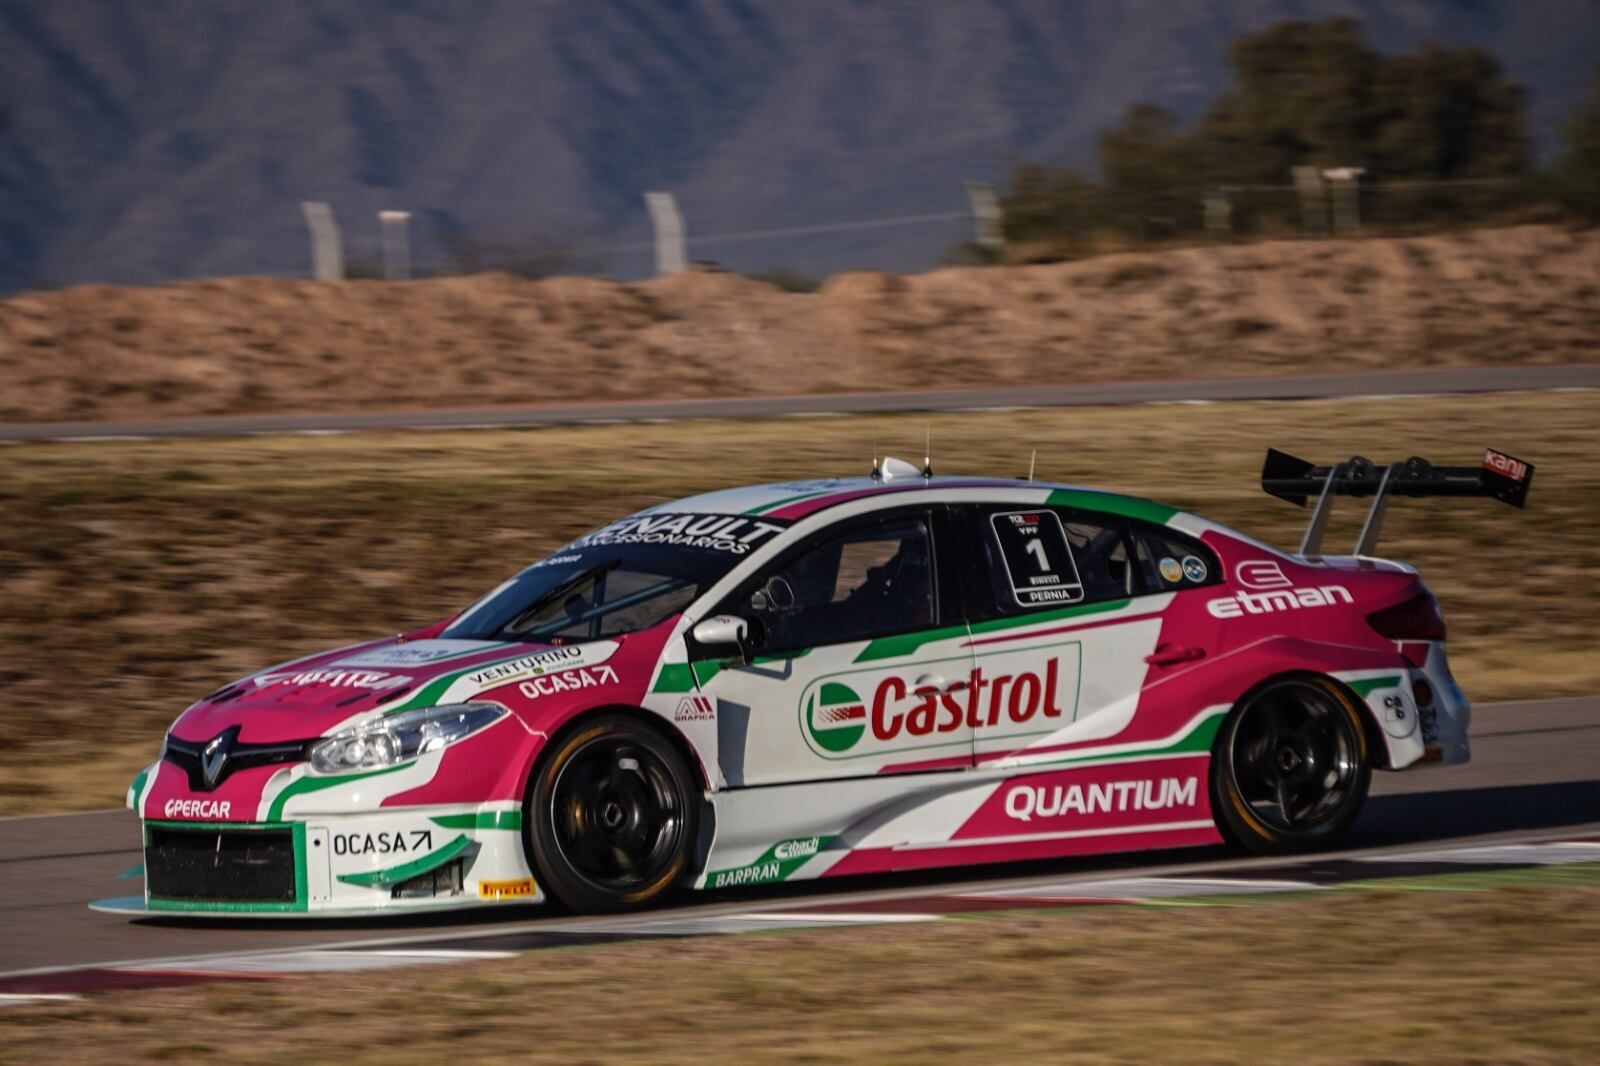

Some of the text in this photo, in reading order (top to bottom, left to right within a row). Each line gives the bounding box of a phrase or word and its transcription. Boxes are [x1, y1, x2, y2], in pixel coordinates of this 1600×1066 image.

[1019, 526, 1039, 535] YPF
[1025, 538, 1051, 571] 1
[1030, 590, 1070, 601] PERNIA
[1206, 585, 1354, 619] etman
[469, 647, 582, 684] VENTURINO
[518, 668, 598, 699] OCASA
[871, 656, 1062, 741] Castrol
[1005, 776, 1198, 821] QUANTIUM
[333, 832, 408, 856] OCASA
[715, 862, 780, 888] BARPRAN
